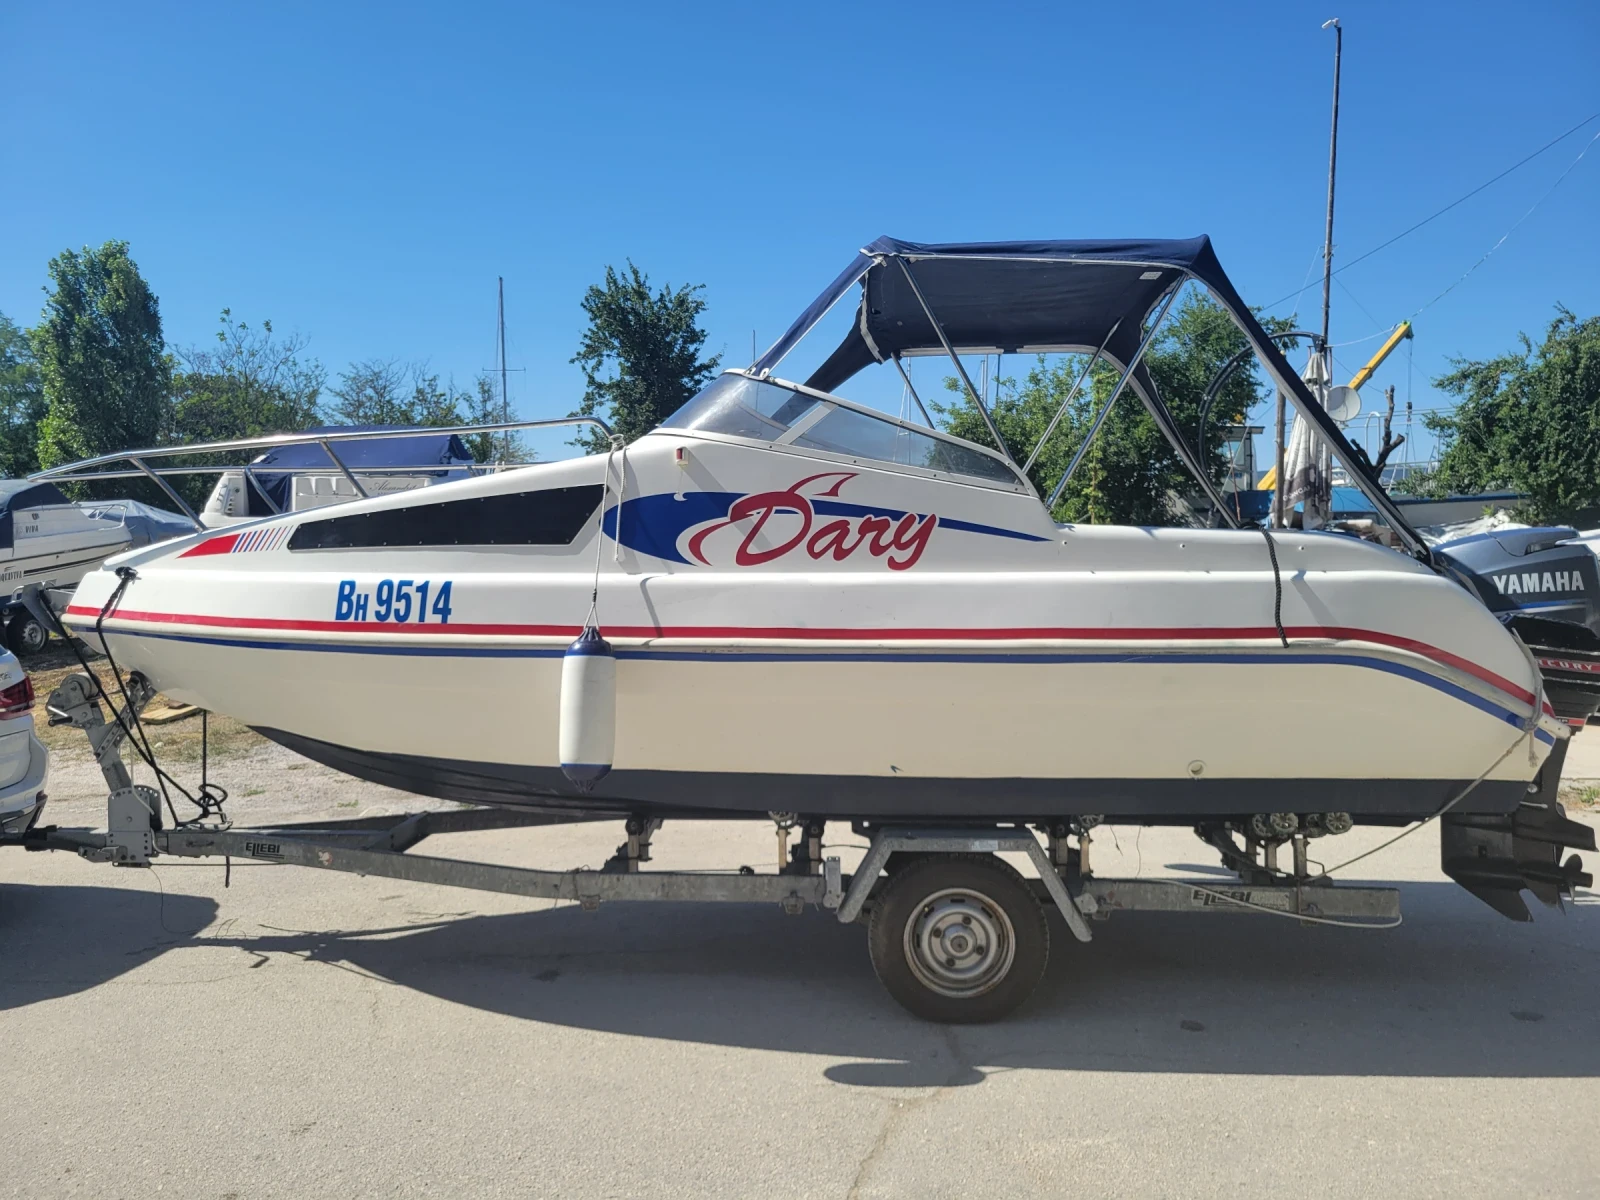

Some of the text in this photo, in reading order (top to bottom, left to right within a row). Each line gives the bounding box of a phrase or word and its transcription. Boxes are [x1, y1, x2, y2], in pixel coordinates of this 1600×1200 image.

[688, 490, 936, 571] Dary
[1492, 570, 1585, 595] YAMAHA
[374, 579, 453, 624] 9514
[246, 842, 283, 858] ELLEBI
